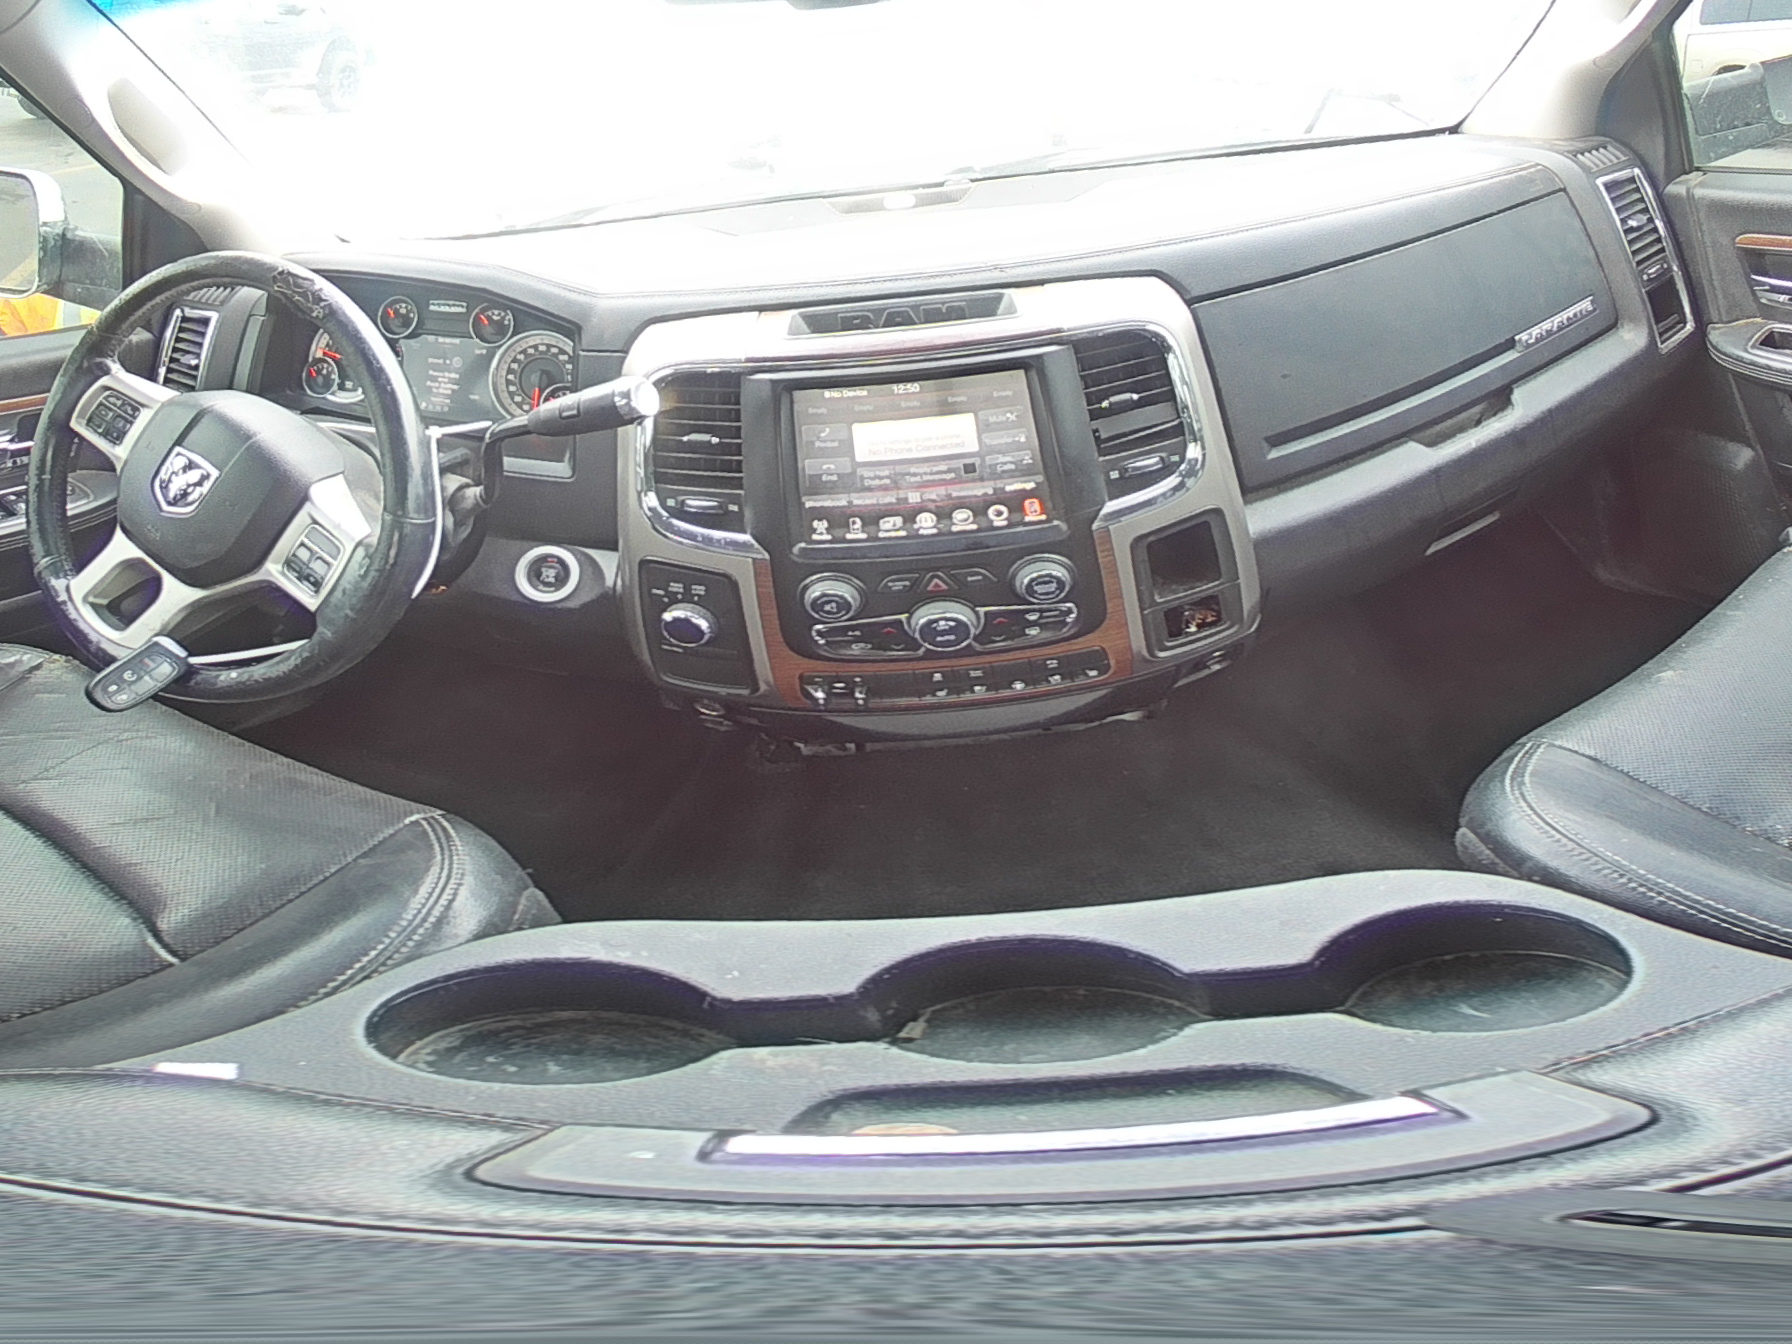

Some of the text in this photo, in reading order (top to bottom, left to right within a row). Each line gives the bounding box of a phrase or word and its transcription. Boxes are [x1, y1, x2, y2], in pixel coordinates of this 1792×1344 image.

[838, 302, 969, 331] RAM
[884, 446, 914, 455] Phone
[914, 440, 966, 453] Connected
